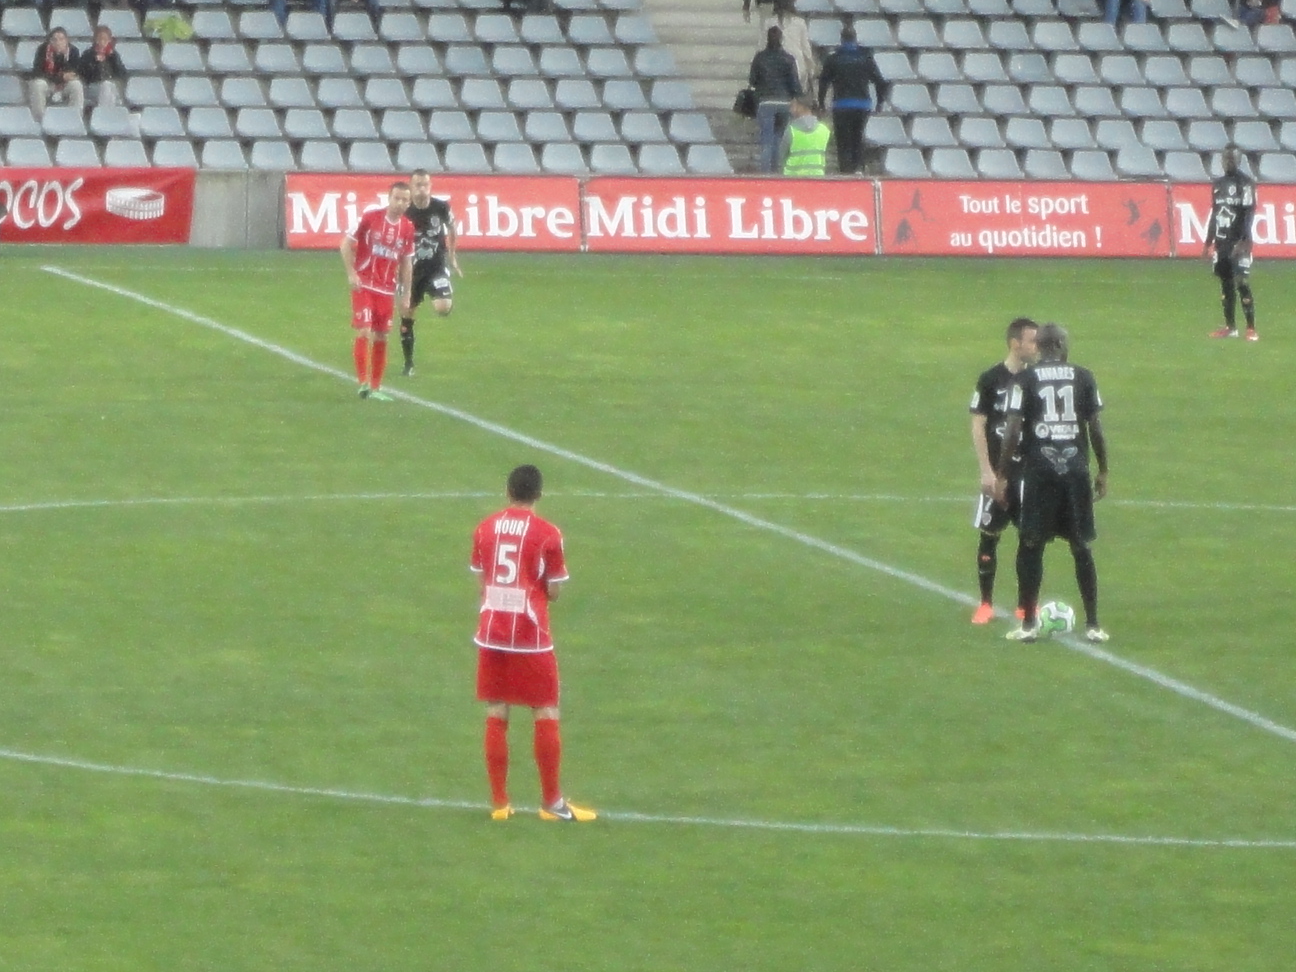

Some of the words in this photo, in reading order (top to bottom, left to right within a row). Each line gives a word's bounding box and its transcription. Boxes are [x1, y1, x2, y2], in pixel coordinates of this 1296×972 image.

[288, 192, 390, 234] Mi
[584, 195, 711, 238] Midi
[725, 197, 869, 241] Libre
[959, 195, 1000, 214] Tout
[1005, 194, 1021, 214] le
[1028, 194, 1089, 221] sport
[1175, 202, 1296, 245] Mdi
[950, 232, 972, 247] au
[978, 224, 1086, 254] quotidien
[1095, 226, 1103, 248] !
[1034, 367, 1075, 381] TAVARES
[1038, 385, 1078, 422] 11
[495, 544, 518, 585] 5
